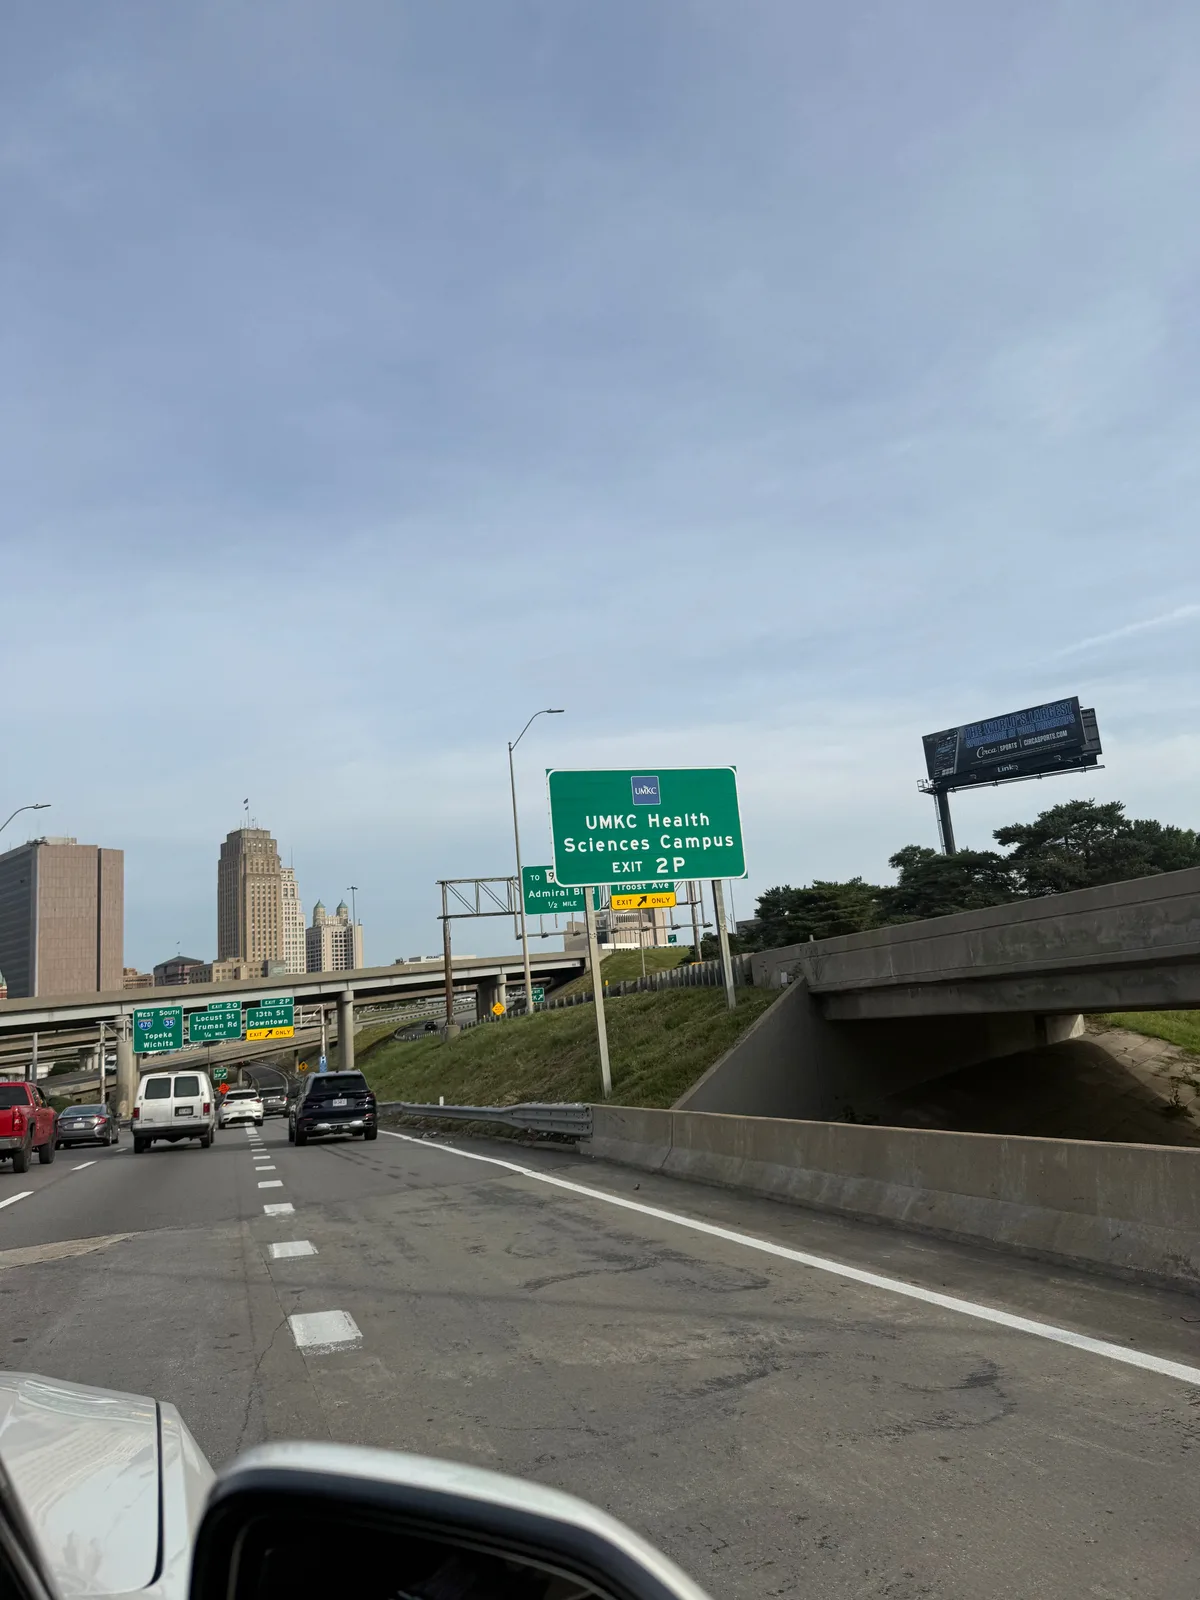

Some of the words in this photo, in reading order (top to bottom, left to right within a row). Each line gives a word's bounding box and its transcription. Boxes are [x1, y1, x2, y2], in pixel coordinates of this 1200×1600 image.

[976, 746, 998, 759] Circa
[999, 741, 1018, 752] SPORTS
[1023, 730, 1068, 747] CIRCASPORTS.COM
[634, 785, 657, 795] UMKC
[586, 814, 637, 829] UMKC
[648, 812, 710, 828] Health
[564, 837, 650, 853] Sciences
[660, 834, 734, 851] Campus
[612, 860, 643, 874] EXIT
[656, 857, 686, 874] 2P
[652, 882, 670, 890] Ave
[528, 888, 569, 898] Admiral
[573, 887, 595, 896] Bld
[195, 1014, 222, 1022] Locust
[255, 1010, 273, 1018] 13th
[193, 1022, 224, 1031] Truman
[249, 1018, 289, 1027] Downtown
[144, 1032, 172, 1040] Topeka
[143, 1040, 174, 1048] Wichita
